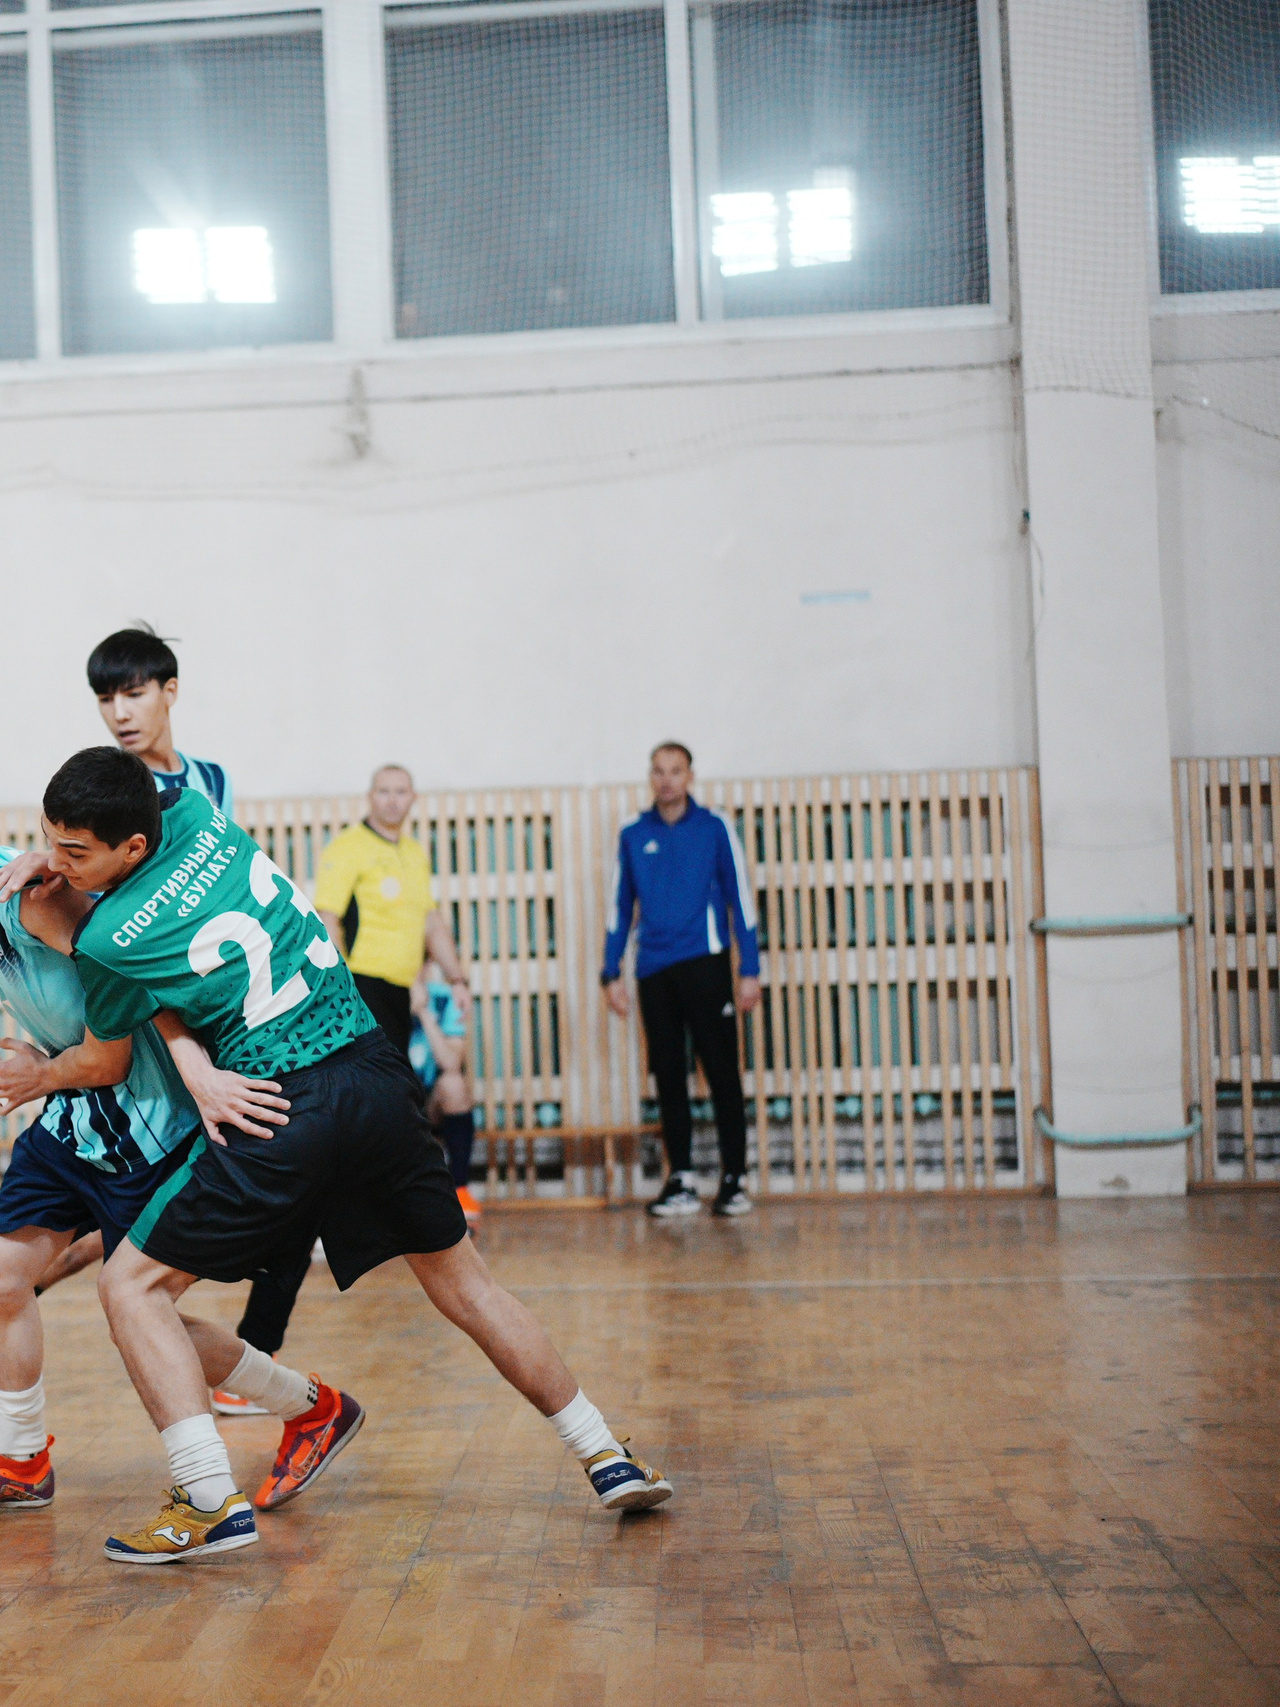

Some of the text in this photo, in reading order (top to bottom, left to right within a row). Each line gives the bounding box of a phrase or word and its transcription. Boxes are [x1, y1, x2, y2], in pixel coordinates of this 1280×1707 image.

[112, 830, 220, 948] СПОРТИВНЫЙ
[177, 845, 238, 917] «БУЛАТ»
[187, 850, 339, 1030] 23
